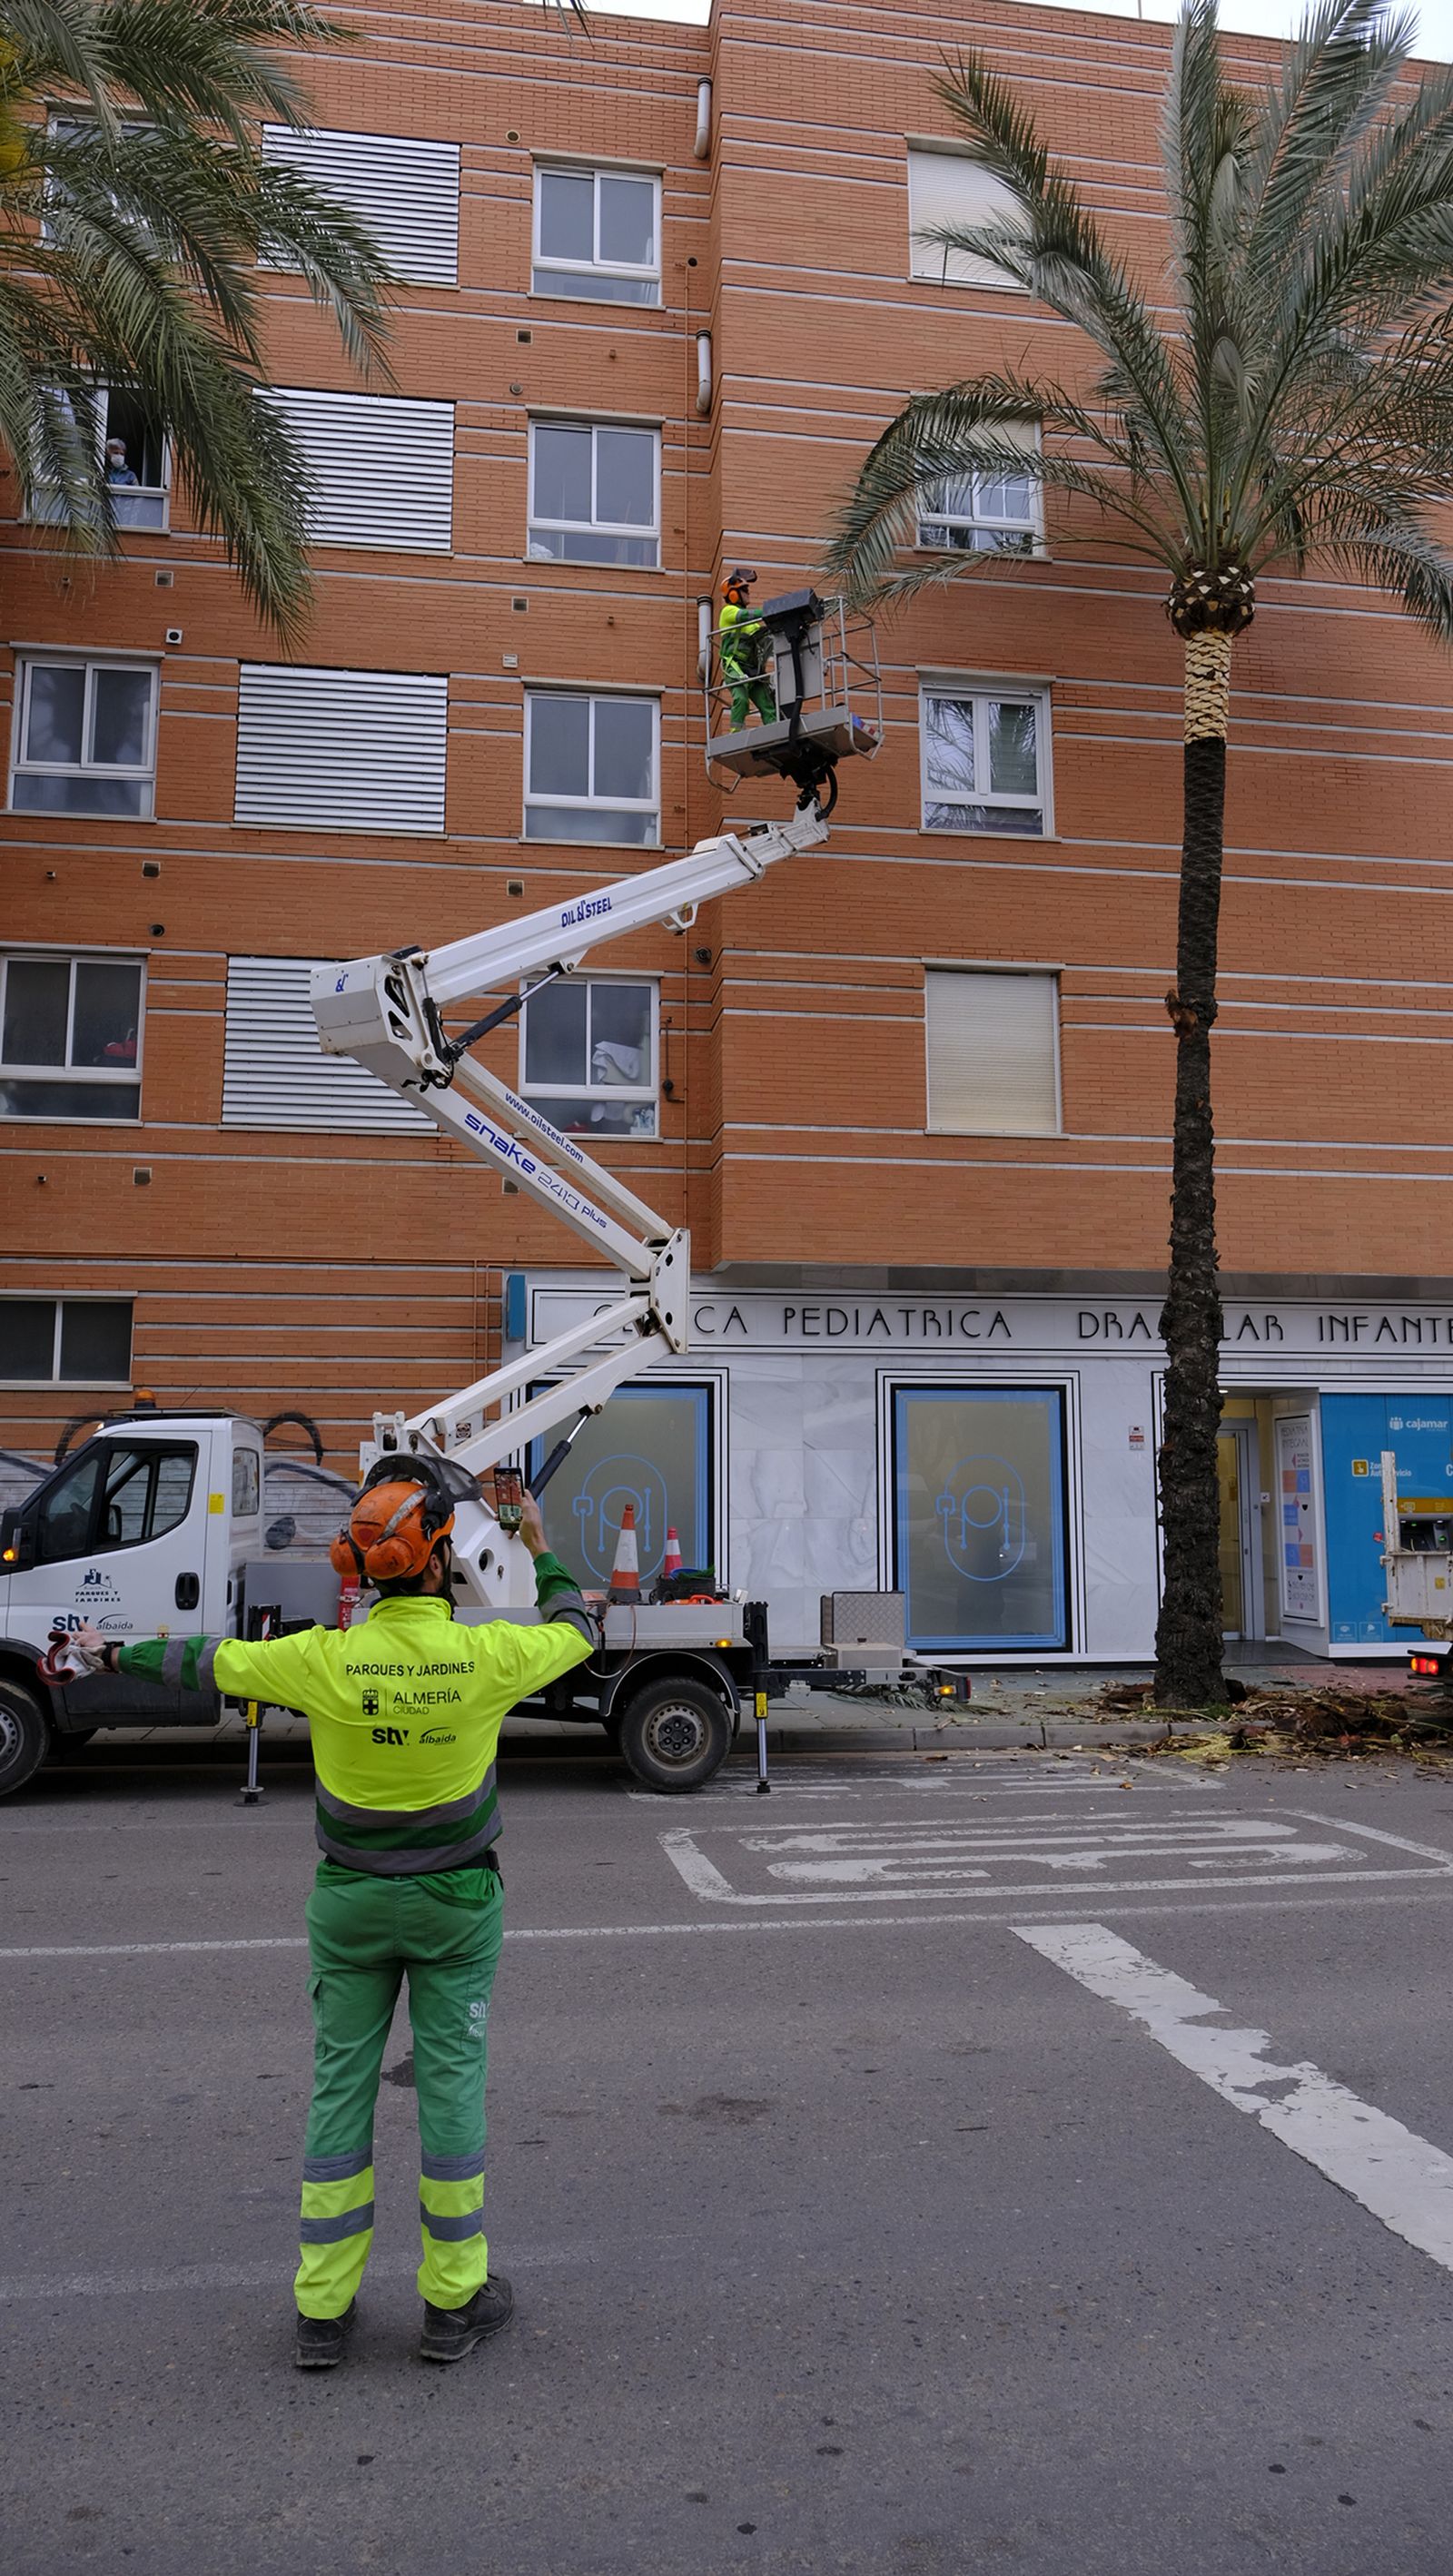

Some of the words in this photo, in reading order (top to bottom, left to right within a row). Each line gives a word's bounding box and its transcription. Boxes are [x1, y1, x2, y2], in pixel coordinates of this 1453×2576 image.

[505, 1092, 584, 1163] www.oilsteel.com
[464, 1113, 536, 1174] snake
[581, 1206, 608, 1229] plus
[784, 1307, 1013, 1338] PEDIATRICA
[1220, 1313, 1284, 1341] LAR
[1405, 1418, 1448, 1431] cajamar
[96, 1622, 133, 1631] albaida
[345, 1663, 404, 1676] PARQUES
[407, 1665, 415, 1676] Y
[416, 1661, 475, 1677] JARDINES
[392, 1687, 461, 1705] ALMERÍA
[392, 1706, 430, 1715] CIUDAD
[371, 1726, 410, 1745] stv
[419, 1733, 457, 1744] albaida
